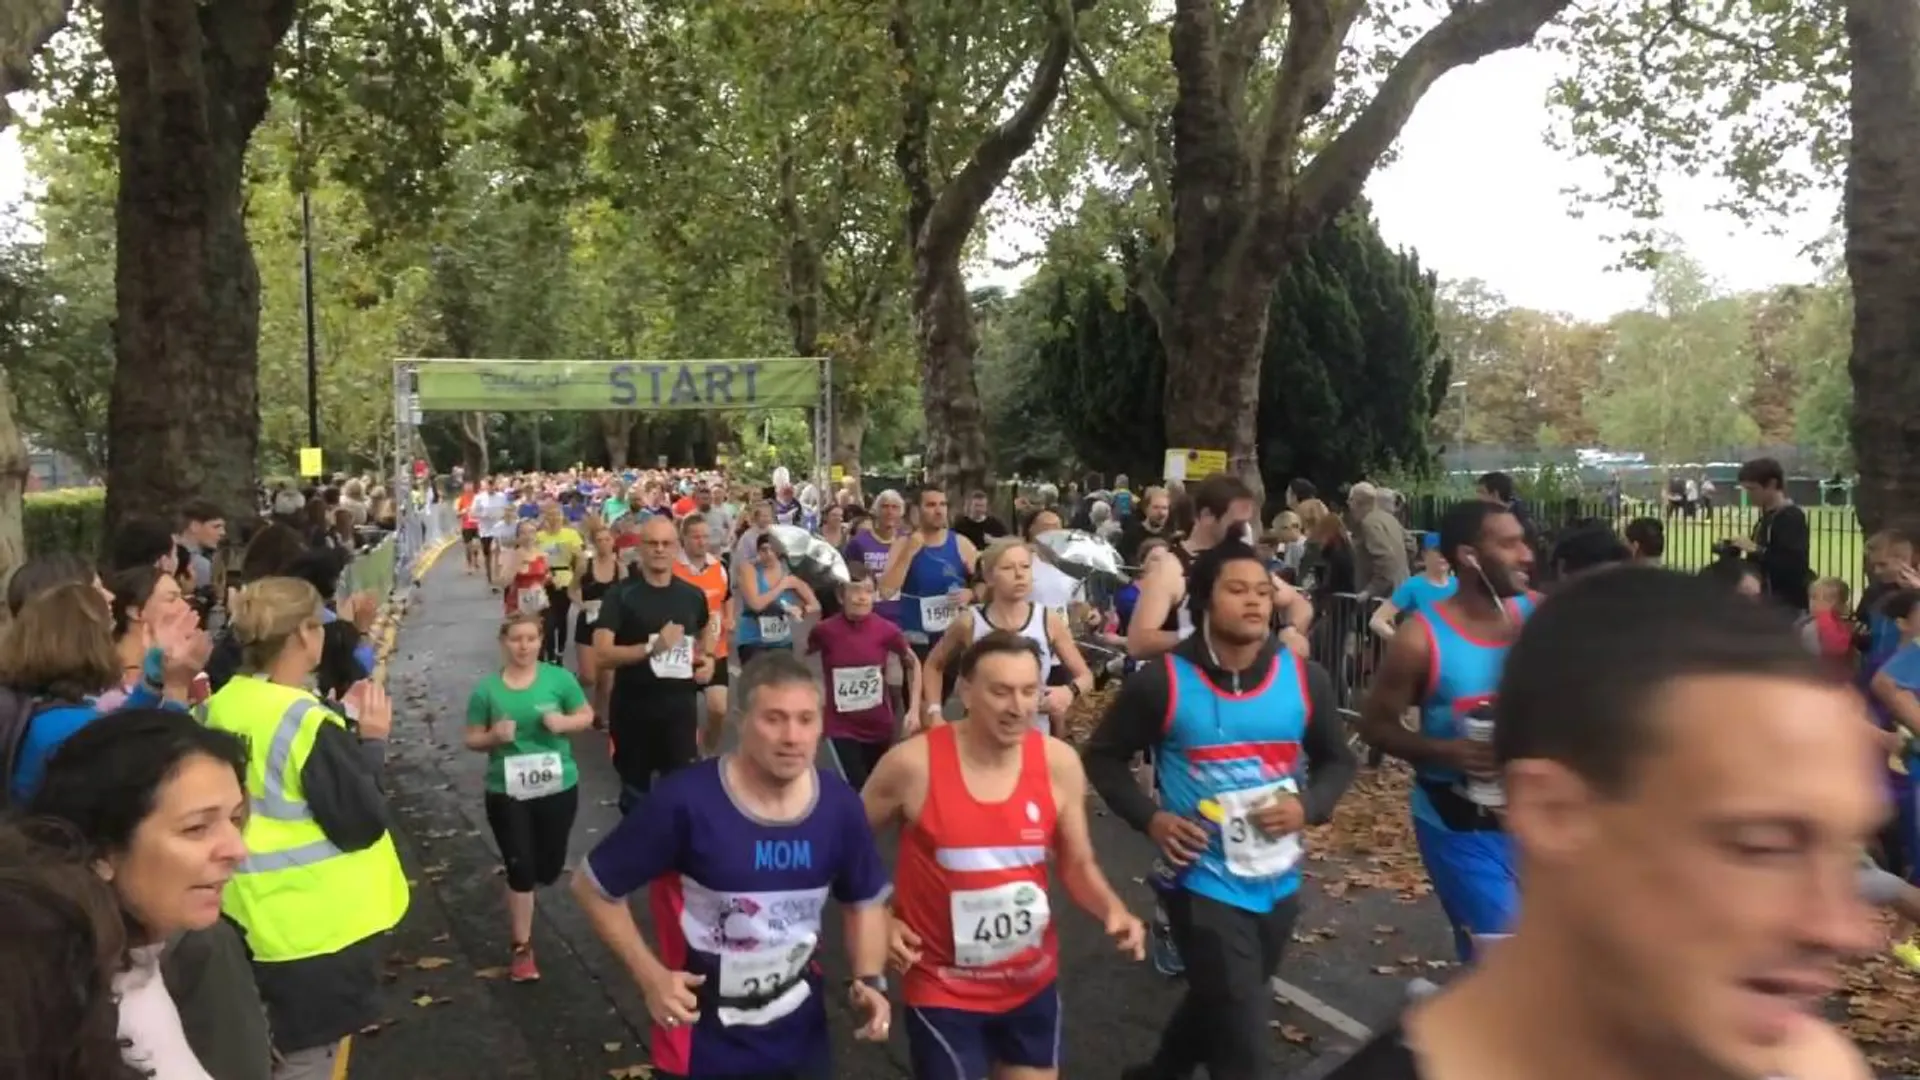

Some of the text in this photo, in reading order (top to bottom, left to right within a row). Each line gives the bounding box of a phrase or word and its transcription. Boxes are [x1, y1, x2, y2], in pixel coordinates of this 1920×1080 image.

[609, 363, 764, 405] START
[838, 679, 879, 697] 4492
[517, 769, 553, 788] 108
[755, 840, 812, 870] MOM
[974, 909, 1032, 943] 403
